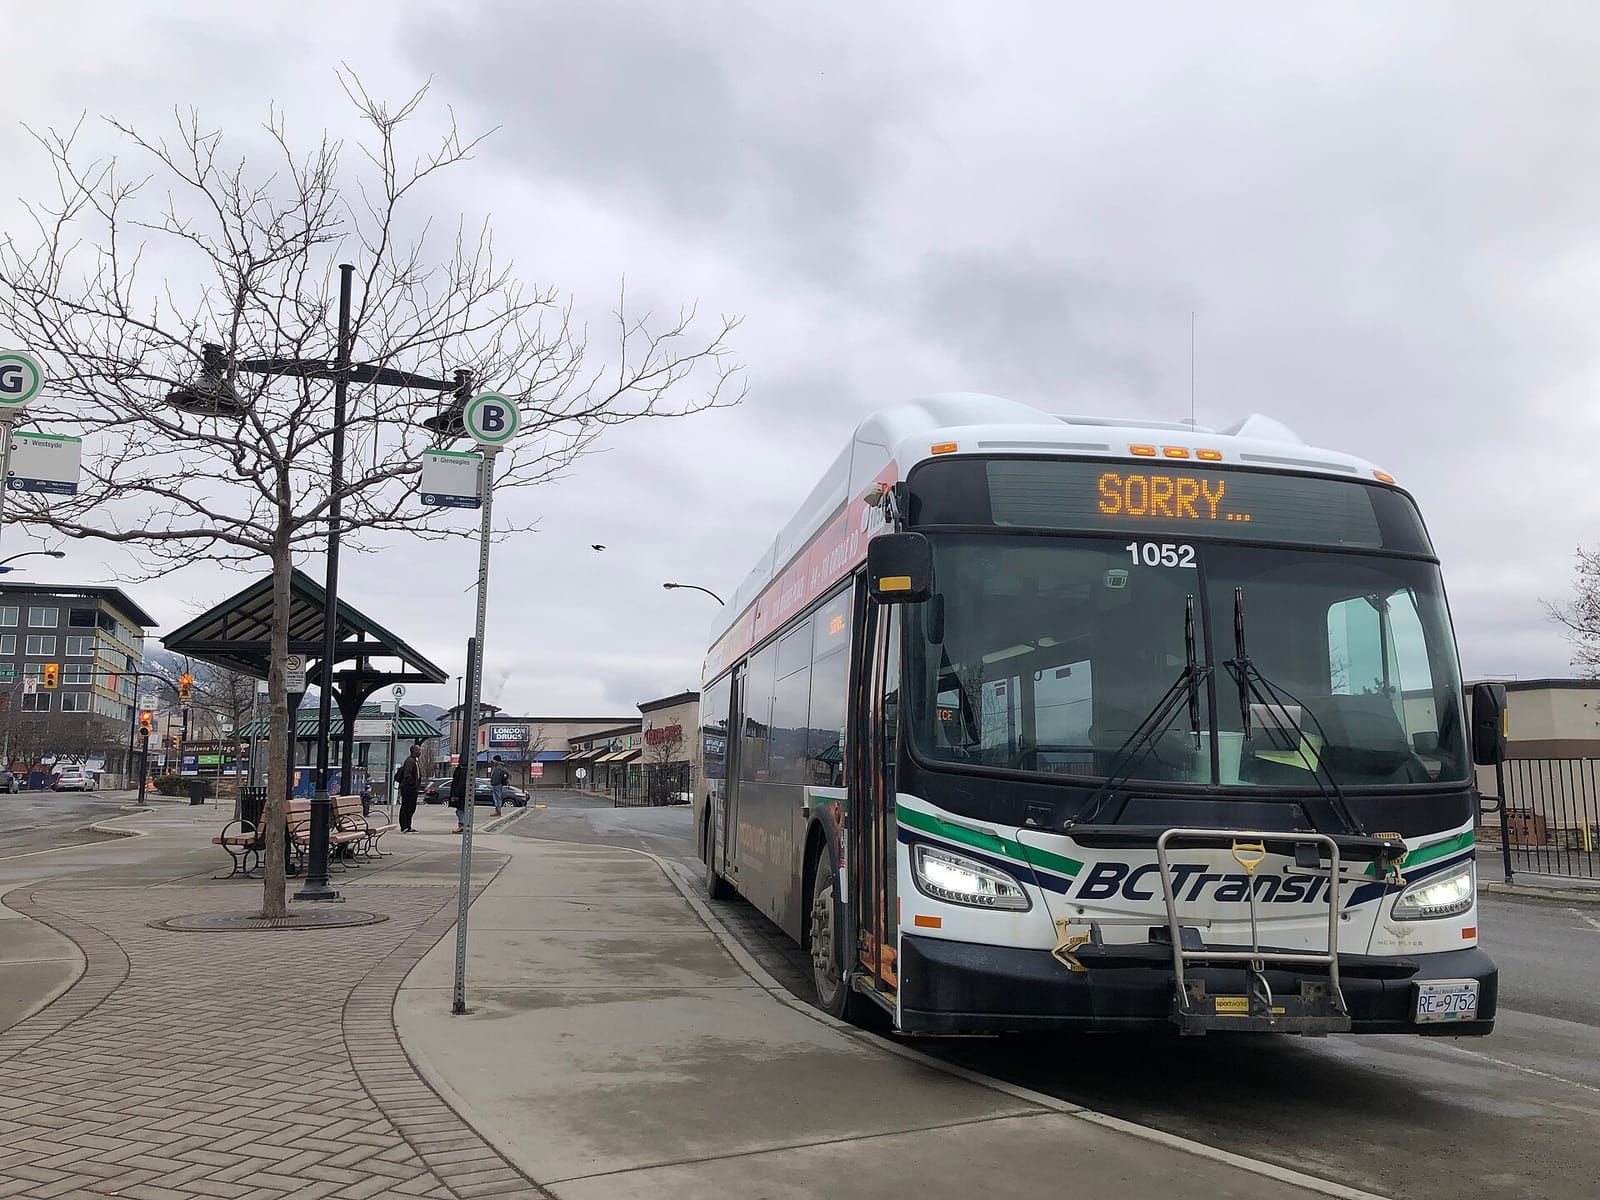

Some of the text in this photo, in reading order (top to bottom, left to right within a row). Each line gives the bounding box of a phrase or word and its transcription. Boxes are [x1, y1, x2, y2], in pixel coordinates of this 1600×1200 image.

[0, 365, 23, 393] G
[482, 405, 504, 431] B
[32, 439, 63, 449] Westsyde
[440, 456, 470, 466] Gleneagles
[1099, 473, 1251, 521] SORRY...
[1126, 542, 1197, 568] 1052
[395, 686, 403, 695] A
[212, 744, 235, 753] Vilage
[1443, 993, 1476, 1012] 9752
